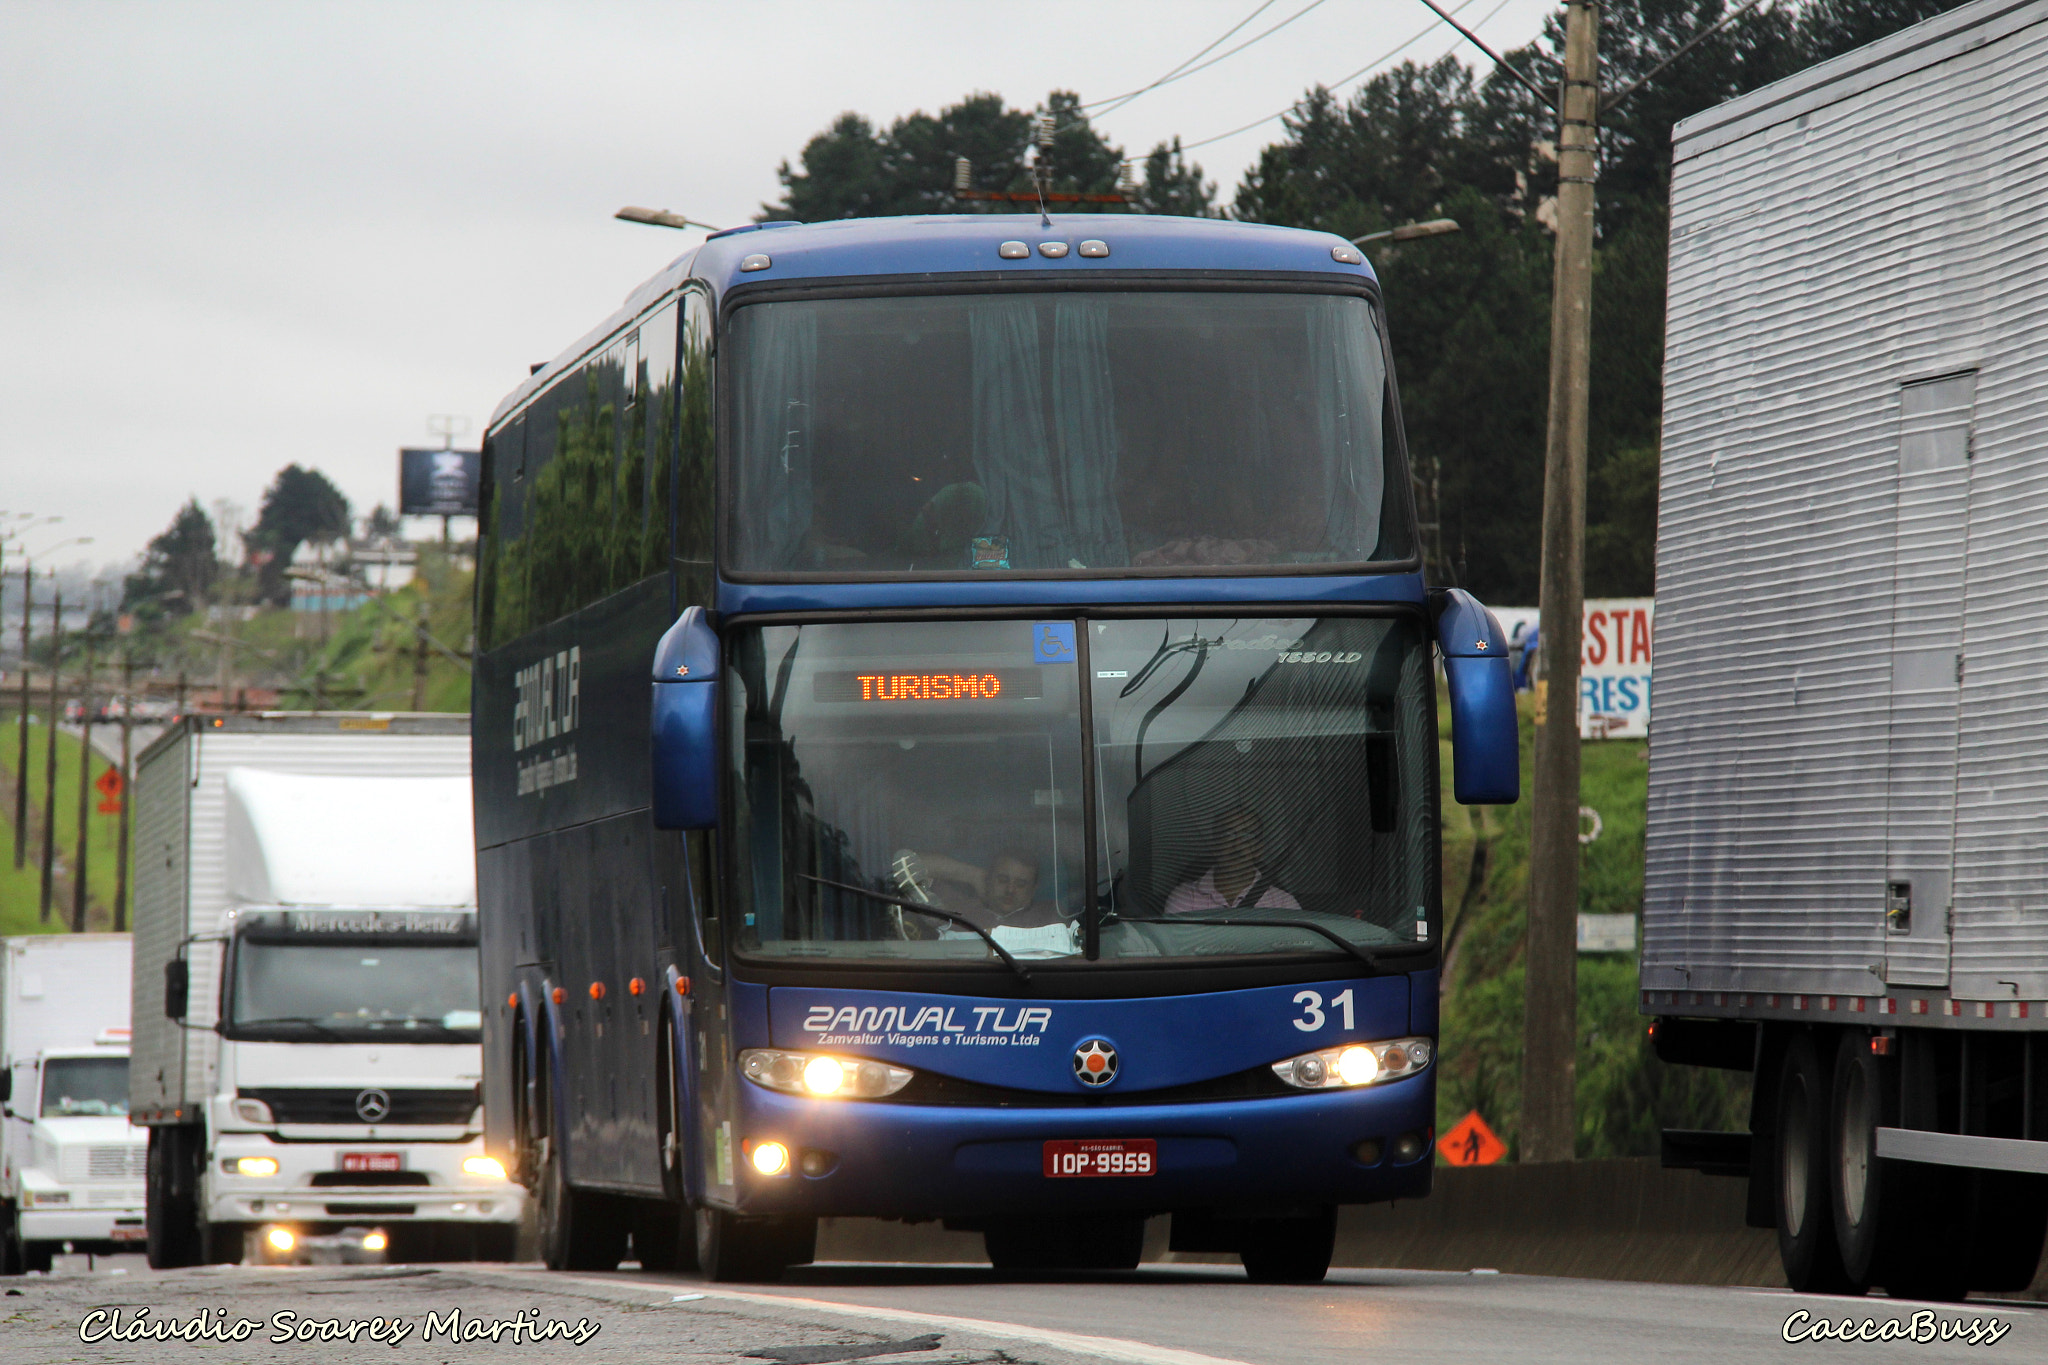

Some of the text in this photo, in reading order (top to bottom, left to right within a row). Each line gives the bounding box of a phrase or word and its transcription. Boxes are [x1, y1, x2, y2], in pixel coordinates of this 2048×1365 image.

[1581, 609, 1653, 665] STA
[1333, 651, 1361, 663] LD
[857, 674, 1000, 700] TURISMO
[295, 911, 462, 934] Mercedes-Benz
[1292, 988, 1355, 1032] 31
[817, 1032, 1040, 1048] Zamvaltur Viagens e Turismo Ltda
